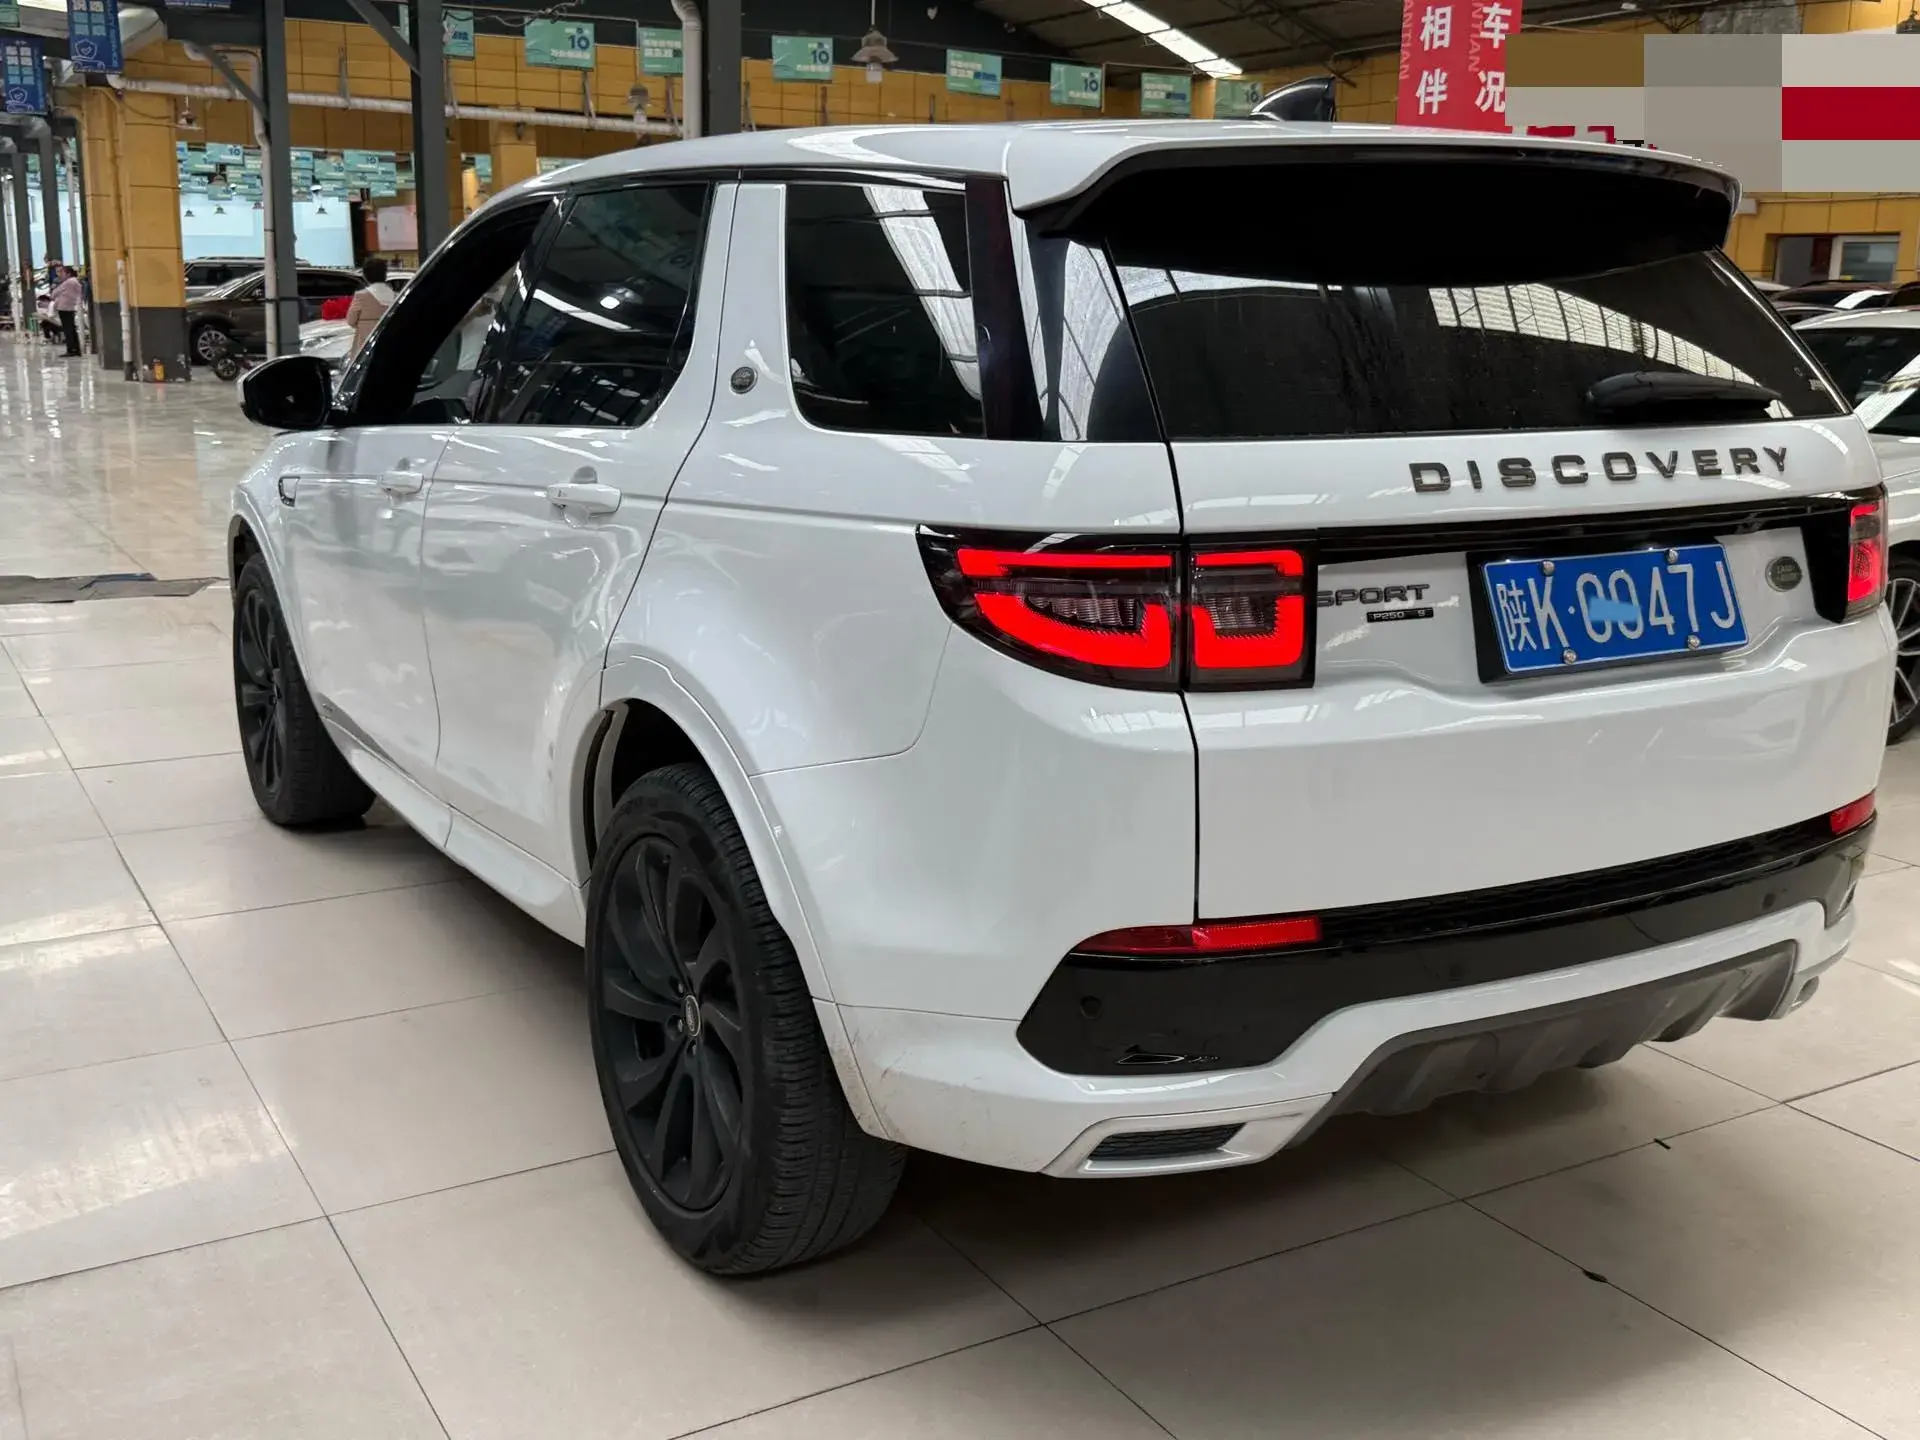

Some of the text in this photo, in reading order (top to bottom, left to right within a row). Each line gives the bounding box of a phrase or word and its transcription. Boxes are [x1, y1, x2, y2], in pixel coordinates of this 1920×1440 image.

[568, 35, 590, 50] 10
[811, 49, 830, 65] 10
[1416, 5, 1452, 115] 相伴
[1475, 2, 1512, 113] 车况
[1083, 78, 1099, 92] 10
[1409, 446, 1787, 493] DISCOVERY
[1317, 583, 1430, 607] SPORT
